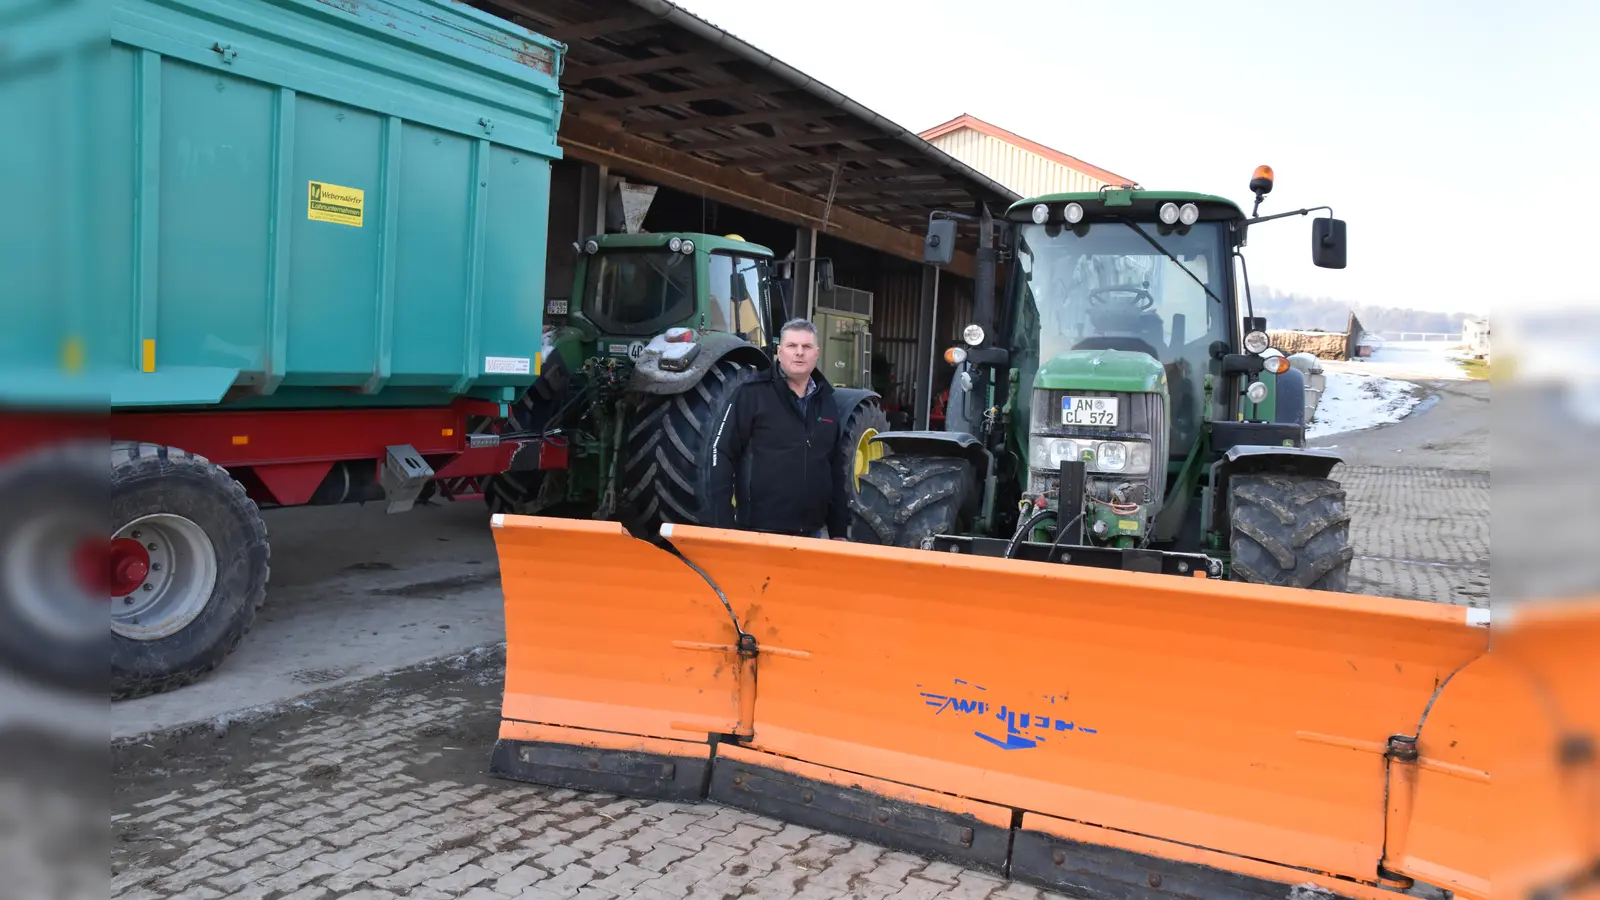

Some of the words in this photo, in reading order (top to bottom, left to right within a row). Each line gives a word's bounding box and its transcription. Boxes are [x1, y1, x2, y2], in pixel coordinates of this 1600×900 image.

[322, 191, 361, 203] Weberndörfer
[311, 202, 360, 216] Lohnunternehmen
[1076, 399, 1093, 411] AN
[1066, 411, 1082, 423] CL
[1089, 412, 1114, 424] 572
